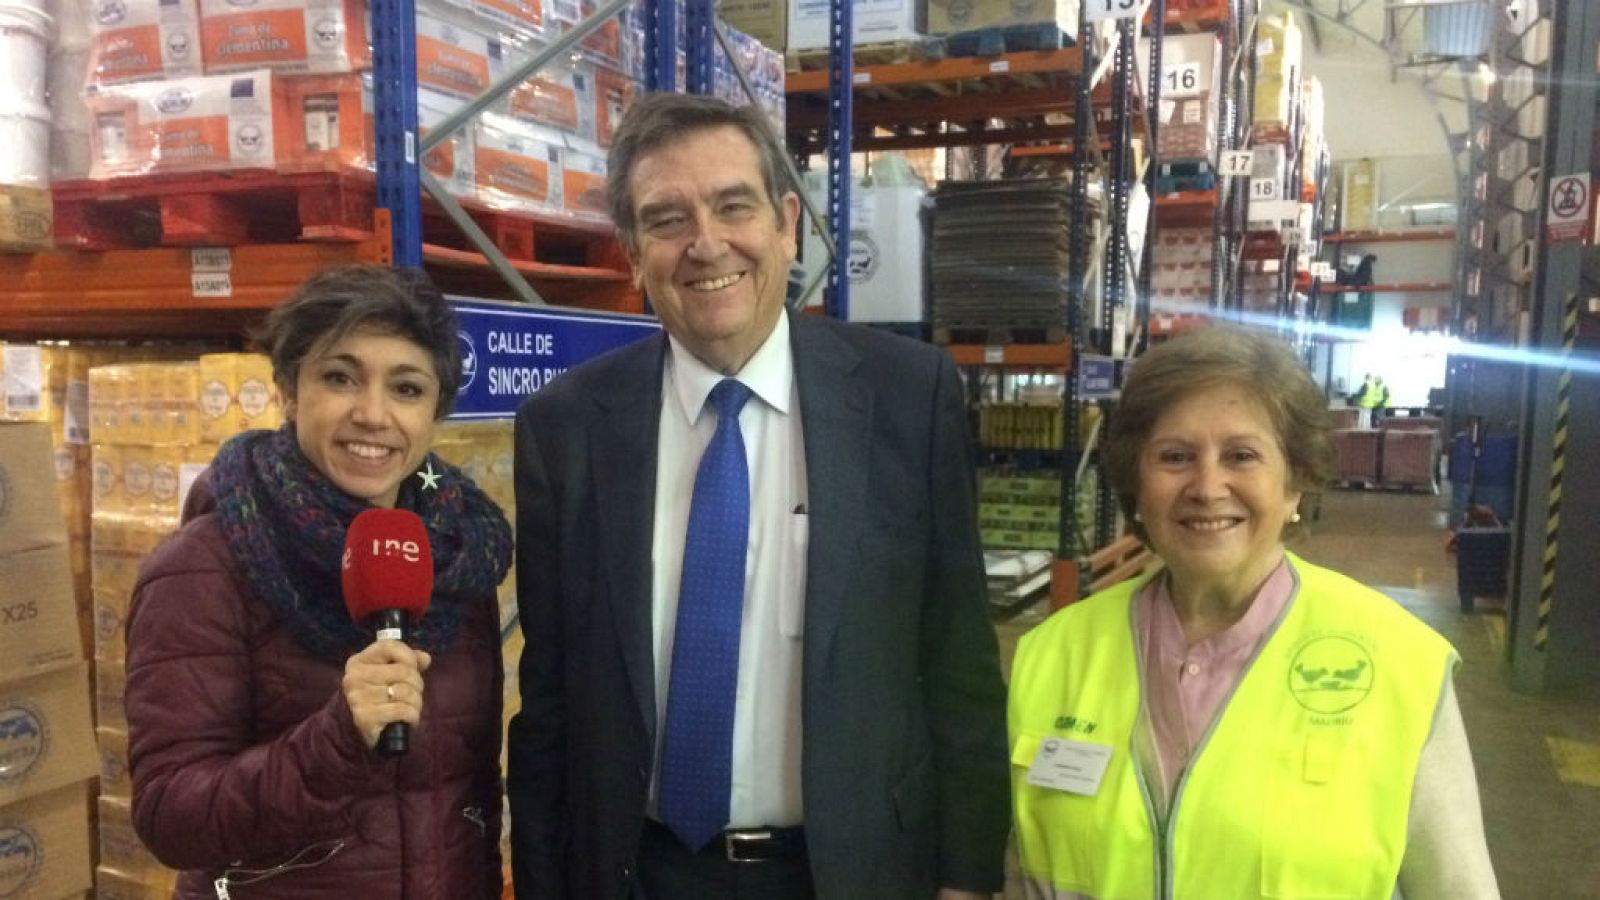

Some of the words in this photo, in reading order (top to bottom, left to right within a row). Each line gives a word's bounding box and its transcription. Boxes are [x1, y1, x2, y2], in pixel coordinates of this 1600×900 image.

[1167, 68, 1195, 90] 16
[1230, 155, 1250, 171] 17
[1255, 182, 1272, 196] 18
[488, 331, 532, 354] CALLE
[535, 333, 554, 355] DE
[488, 366, 541, 395] SINCRO
[2, 601, 38, 625] X25
